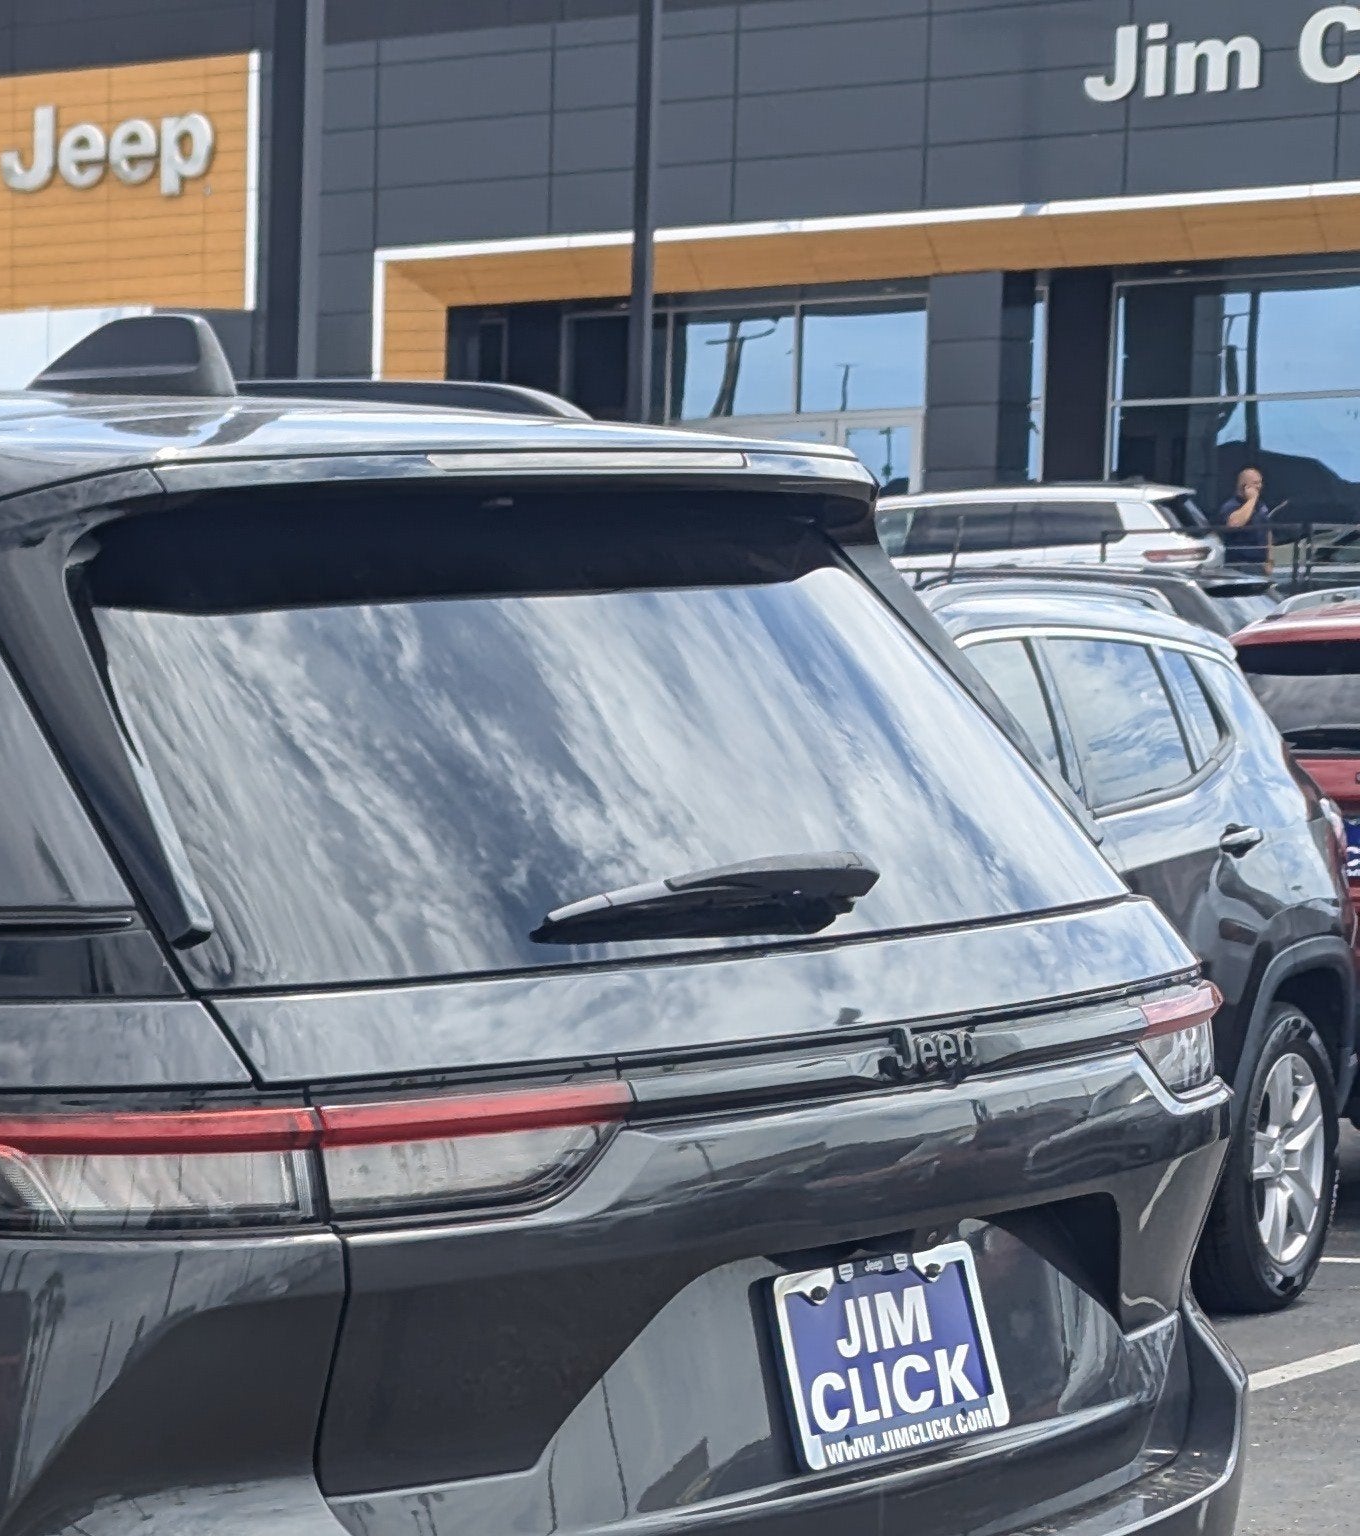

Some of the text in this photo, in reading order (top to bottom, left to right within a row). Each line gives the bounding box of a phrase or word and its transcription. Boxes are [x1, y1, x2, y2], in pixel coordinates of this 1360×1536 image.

[1083, 22, 1261, 102] Jim
[0, 105, 214, 197] Jeep
[896, 1025, 978, 1071] Jeep
[836, 1286, 932, 1358] JIM
[810, 1344, 980, 1433] CLICK
[825, 1407, 993, 1465] WWW.JIMCLICK.COM
